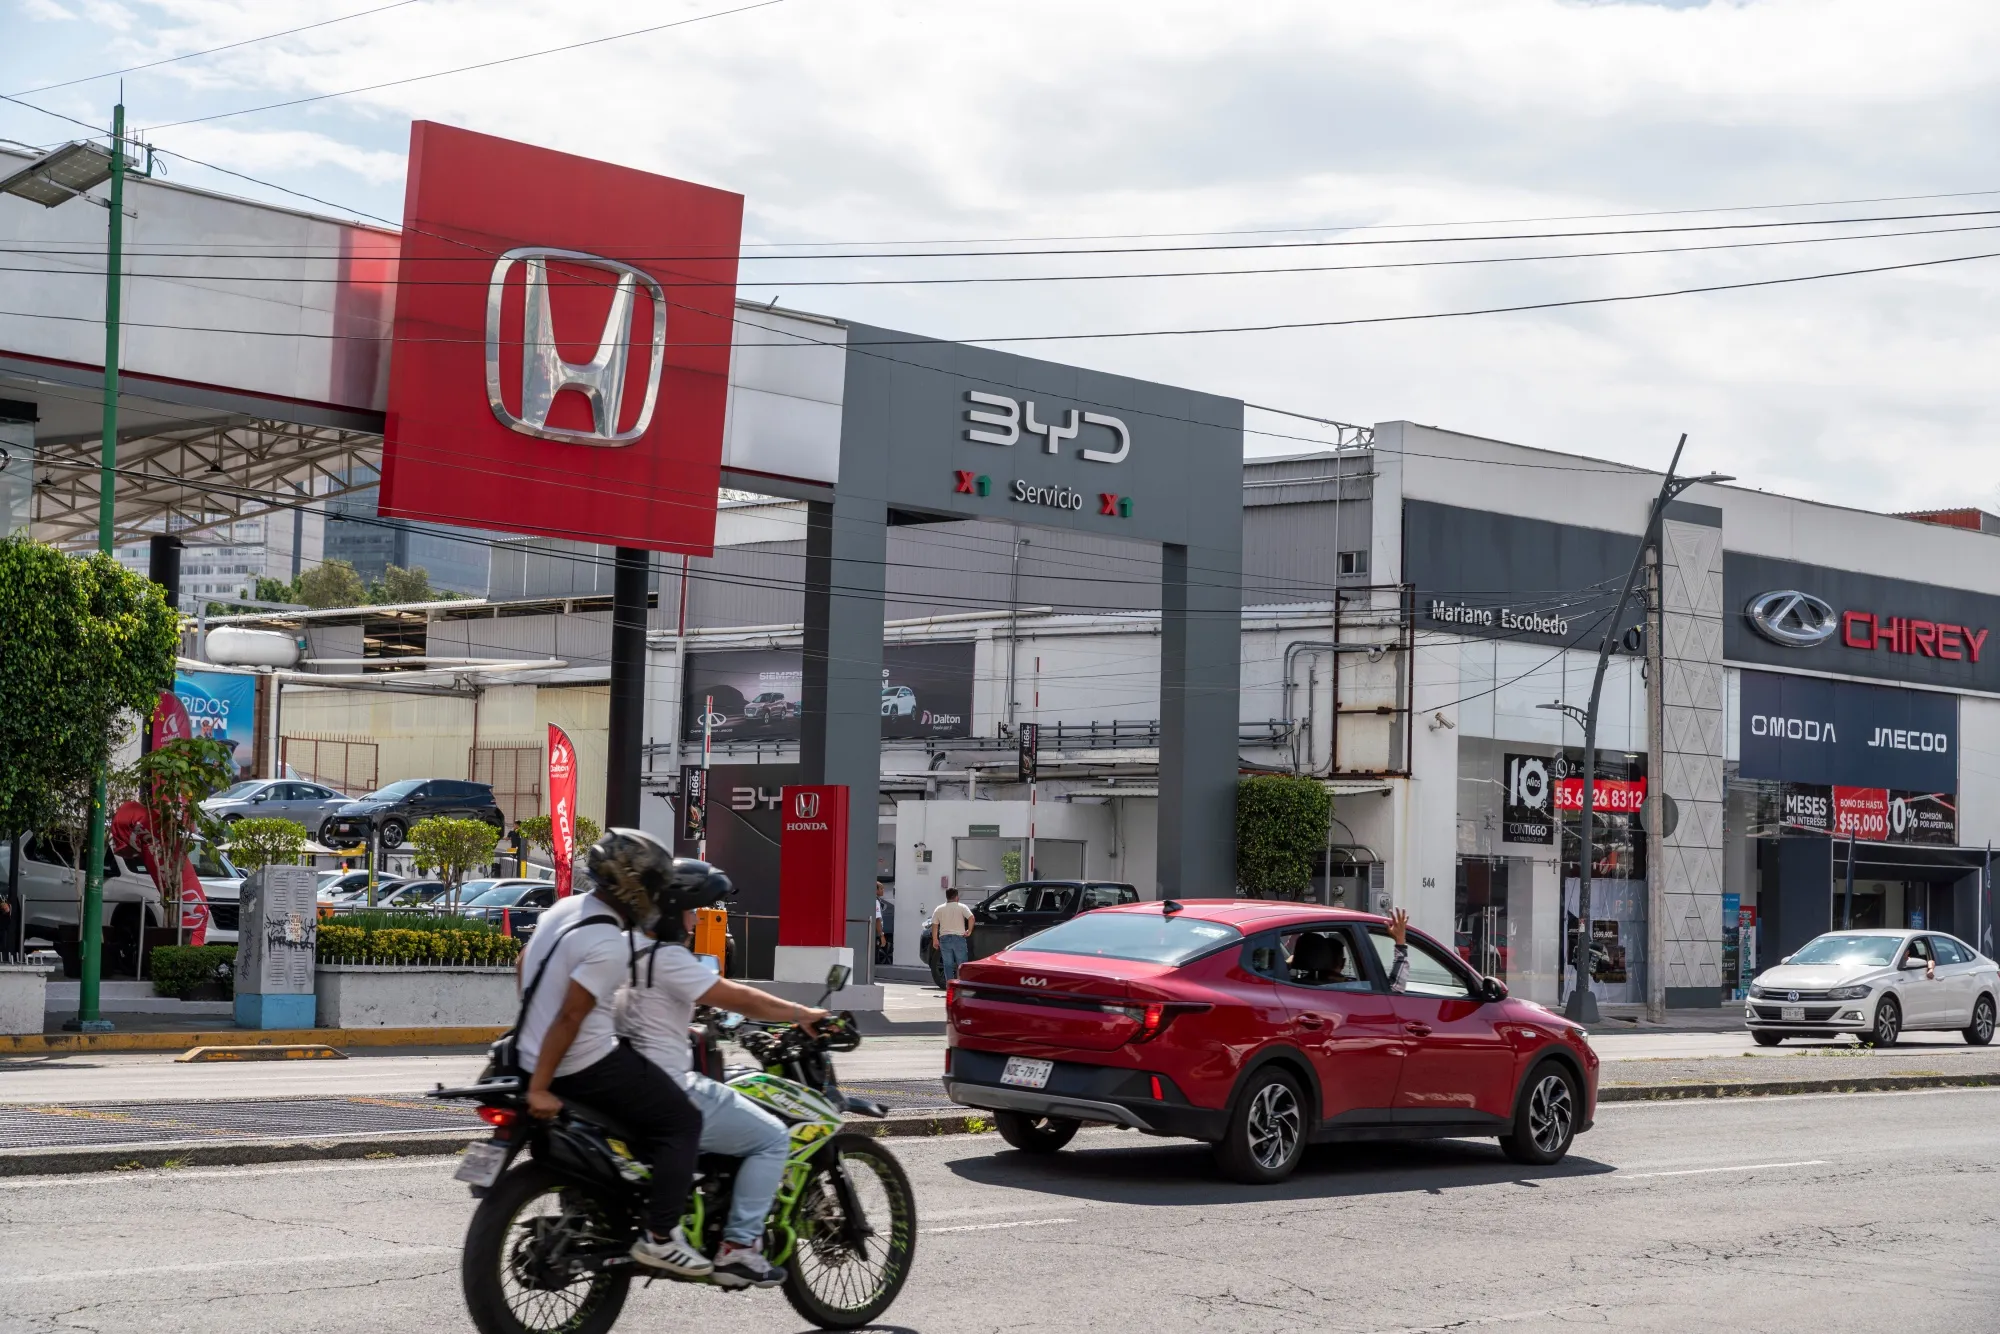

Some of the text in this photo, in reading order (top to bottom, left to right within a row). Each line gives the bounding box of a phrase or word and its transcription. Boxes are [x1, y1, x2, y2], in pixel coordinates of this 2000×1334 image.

[966, 390, 1131, 463] BYD
[1014, 479, 1083, 511] Servicio
[1432, 599, 1568, 636] Mariano Escobedo
[1842, 610, 1989, 663] CHIREY
[933, 714, 961, 724] Dalton
[1751, 714, 1947, 753] OMODA JAECOO
[732, 786, 783, 810] BY
[1555, 787, 1643, 808] 55 626 8312
[1786, 794, 1827, 817] MESES
[1840, 798, 1884, 809] BONO DE HASTA
[557, 797, 573, 866] NDA
[786, 822, 828, 831] HONDA
[1786, 815, 1827, 827] SIN INTERESES
[1839, 810, 1884, 835] $55,000
[1919, 820, 1954, 830] POR APERTURA
[1422, 877, 1435, 889] 544
